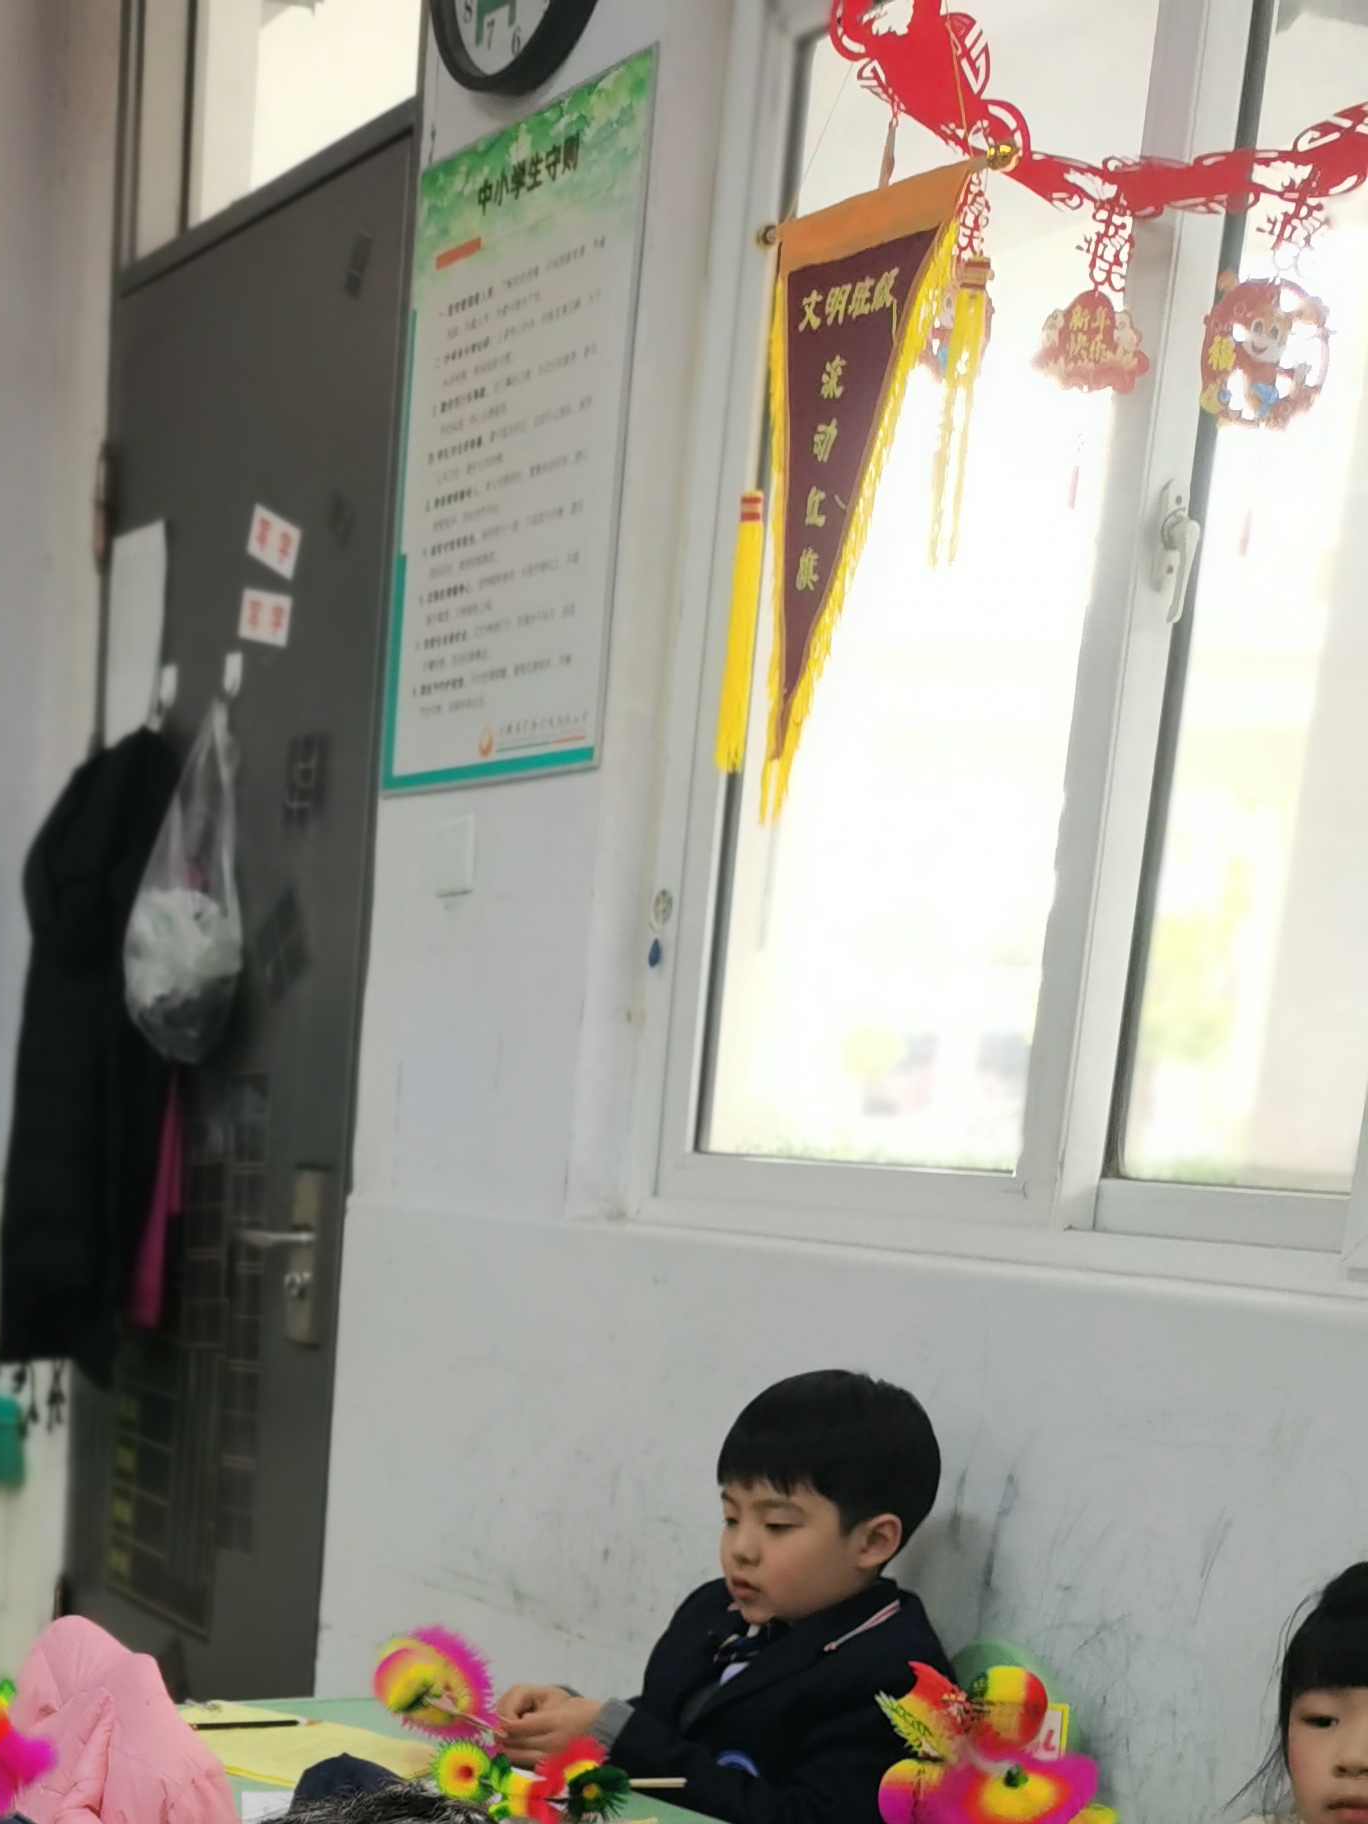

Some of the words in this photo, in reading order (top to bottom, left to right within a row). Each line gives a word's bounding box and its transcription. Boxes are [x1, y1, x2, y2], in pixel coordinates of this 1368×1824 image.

[477, 130, 580, 216] 中小学生守则
[798, 267, 899, 333] 文明班级
